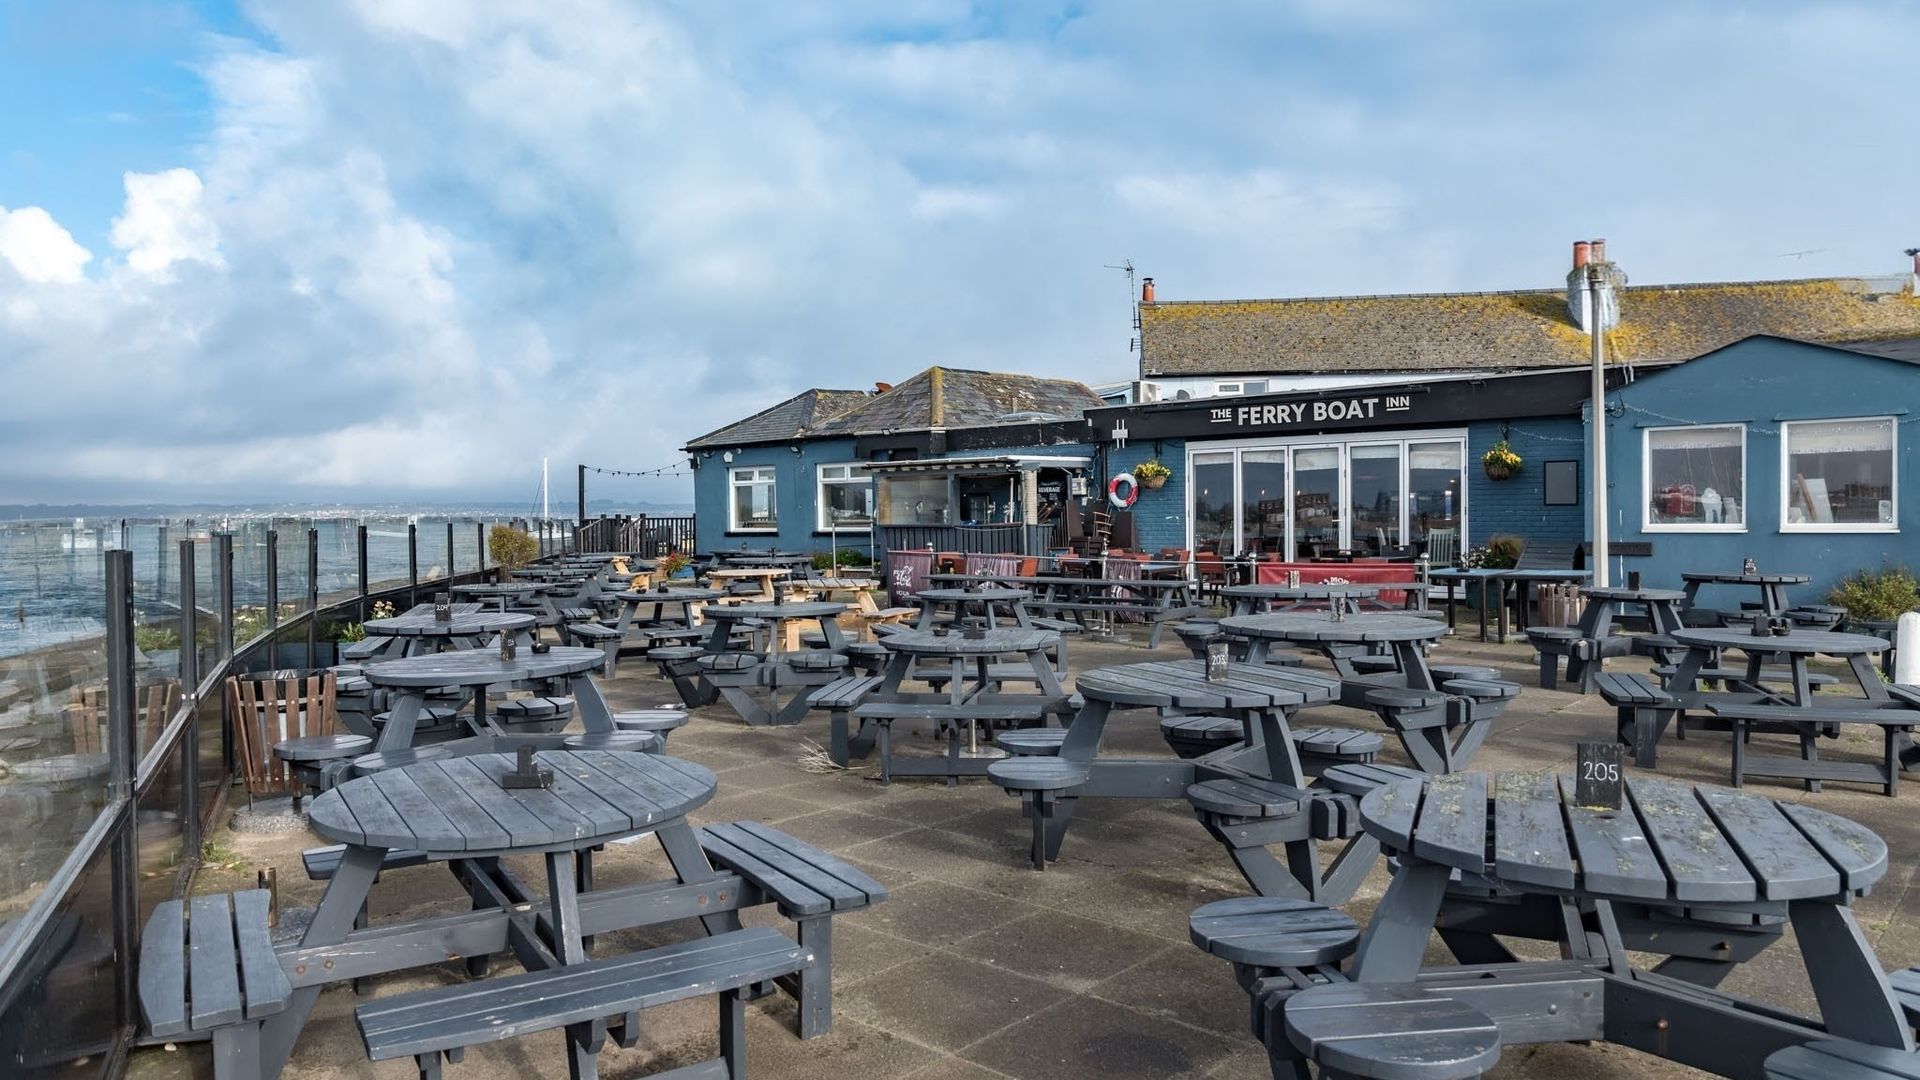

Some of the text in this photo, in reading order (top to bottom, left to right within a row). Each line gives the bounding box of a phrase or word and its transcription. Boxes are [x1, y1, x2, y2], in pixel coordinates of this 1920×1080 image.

[1210, 396, 1410, 426] THE FERRY BOAT INN
[1583, 761, 1619, 782] 205
